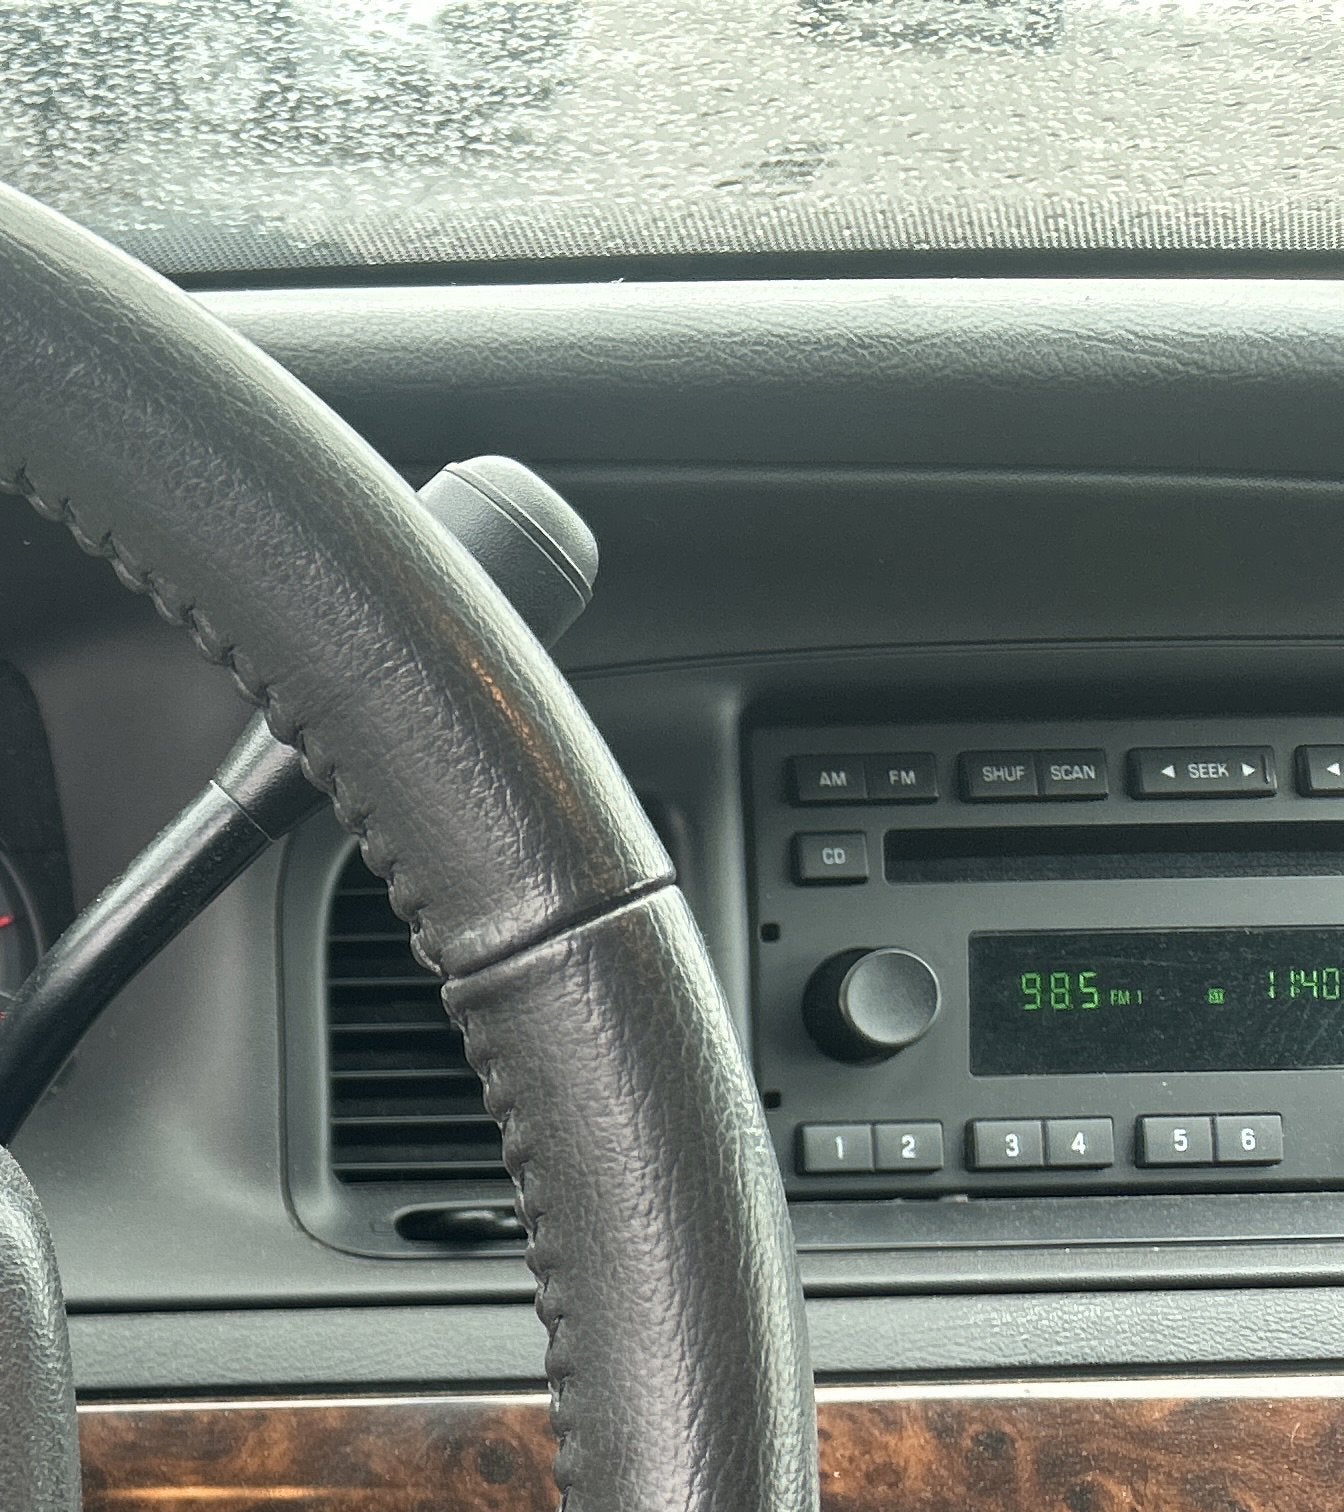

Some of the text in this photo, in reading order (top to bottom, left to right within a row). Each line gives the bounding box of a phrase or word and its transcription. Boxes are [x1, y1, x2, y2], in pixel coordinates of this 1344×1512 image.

[818, 769, 848, 788] AM
[888, 768, 916, 786] FM
[981, 765, 1026, 783] SHUF
[1050, 764, 1096, 782] SCAN
[1187, 763, 1229, 780] SEEK
[822, 847, 847, 866] CD
[1267, 967, 1342, 1001] 11:40
[834, 1136, 845, 1160] 1
[901, 1135, 917, 1160] 2
[1005, 1134, 1021, 1158] 3
[1070, 1131, 1087, 1155] 4
[1172, 1129, 1189, 1152] 5
[1240, 1128, 1256, 1151] 6
